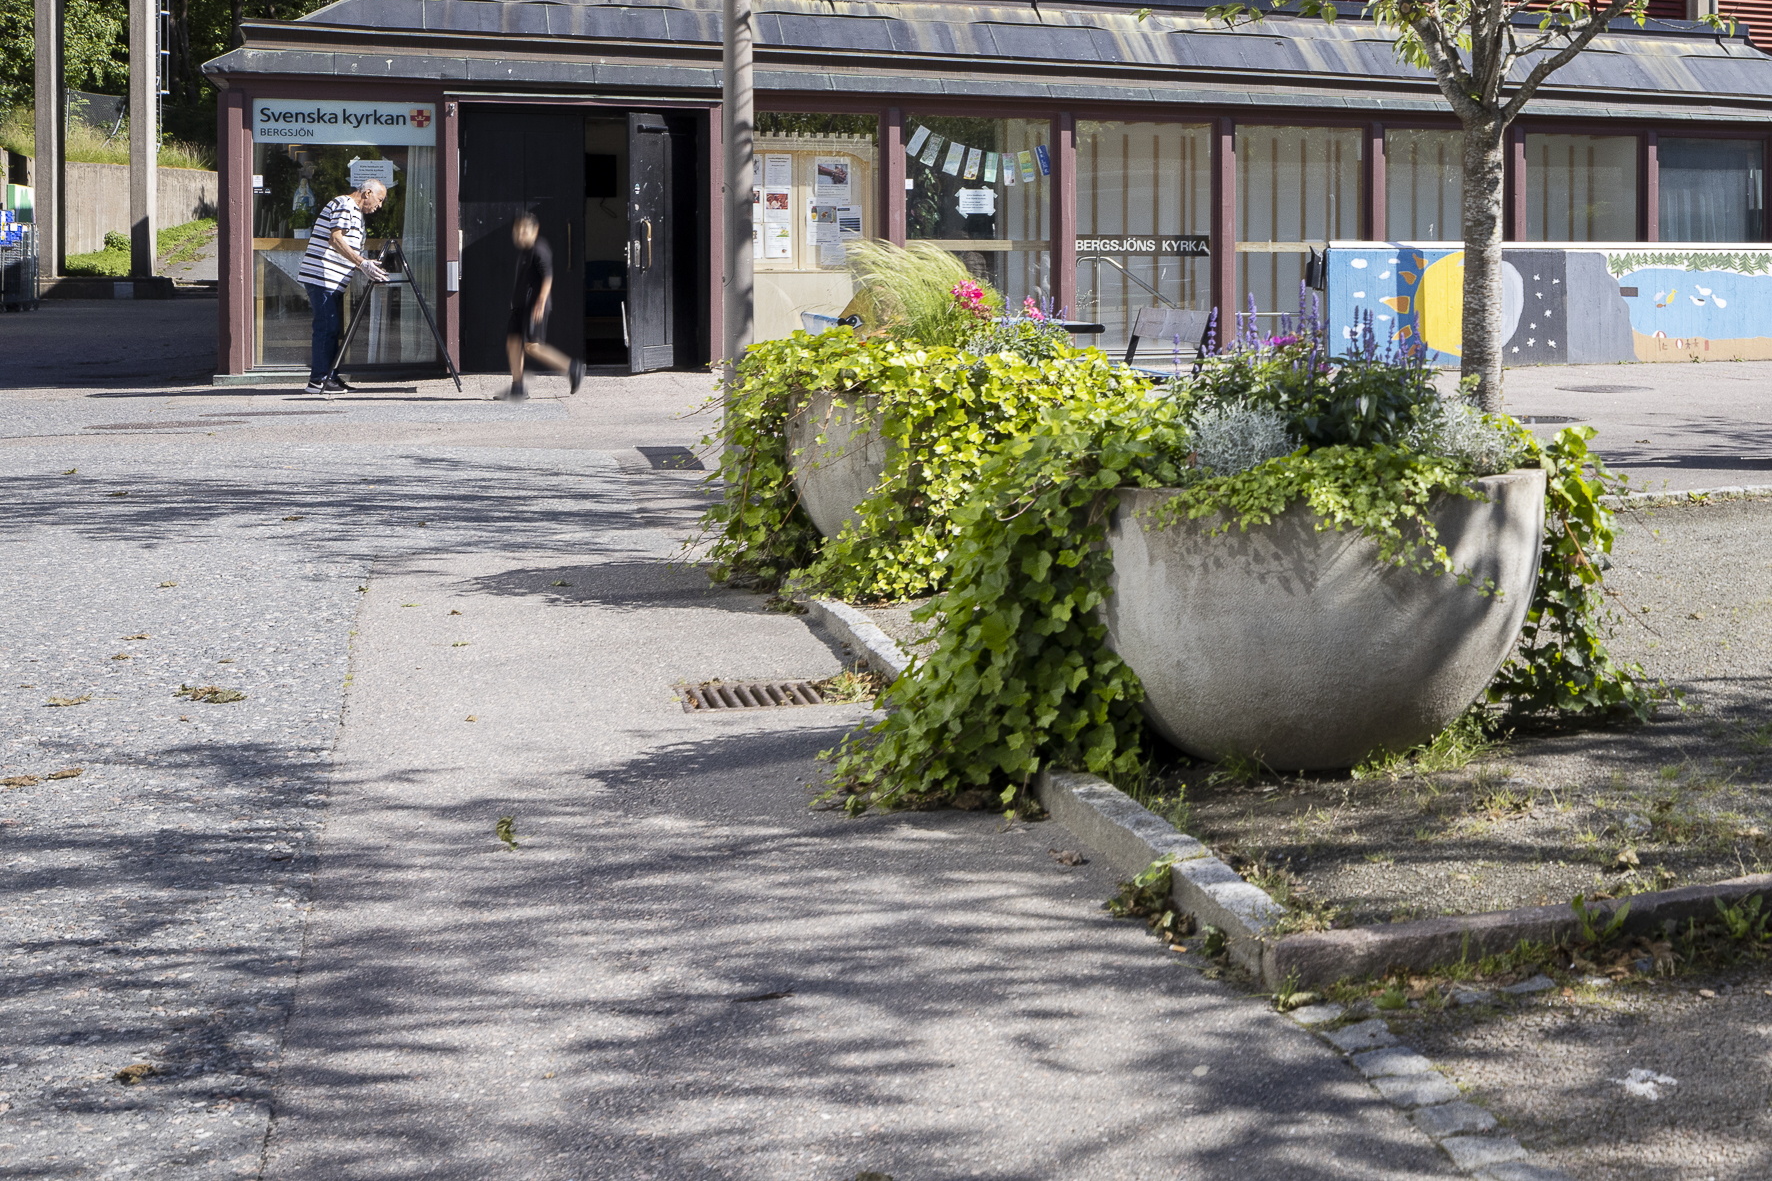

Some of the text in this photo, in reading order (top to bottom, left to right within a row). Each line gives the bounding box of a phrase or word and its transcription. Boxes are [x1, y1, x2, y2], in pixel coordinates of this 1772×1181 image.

[259, 107, 407, 128] Svenska kyrkan
[259, 127, 314, 137] BERGSJÖN
[1075, 238, 1208, 251] BERGSJÖNS KYRKA
